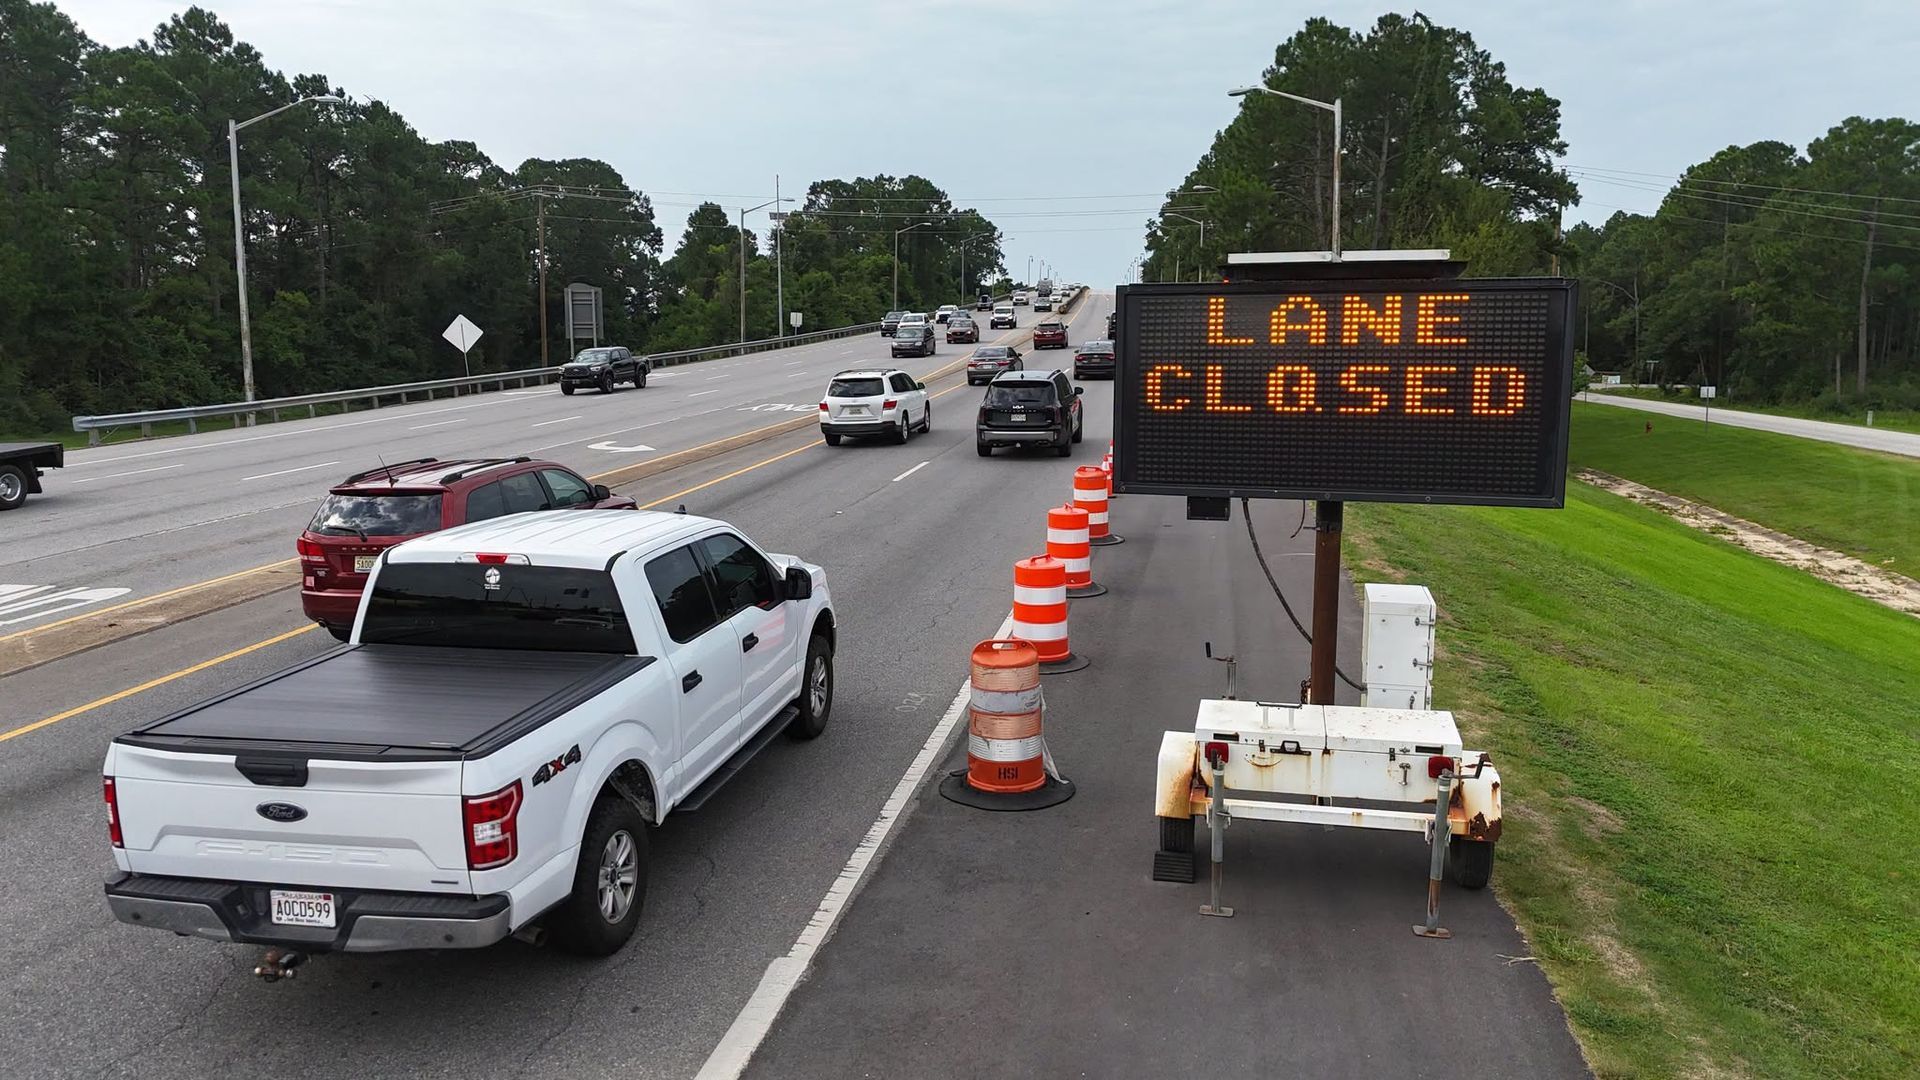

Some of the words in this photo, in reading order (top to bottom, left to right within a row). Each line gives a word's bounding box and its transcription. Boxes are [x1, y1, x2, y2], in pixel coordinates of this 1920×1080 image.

[1207, 295, 1470, 345] LANE
[998, 766, 1018, 780] HSI
[267, 805, 295, 819] Ford
